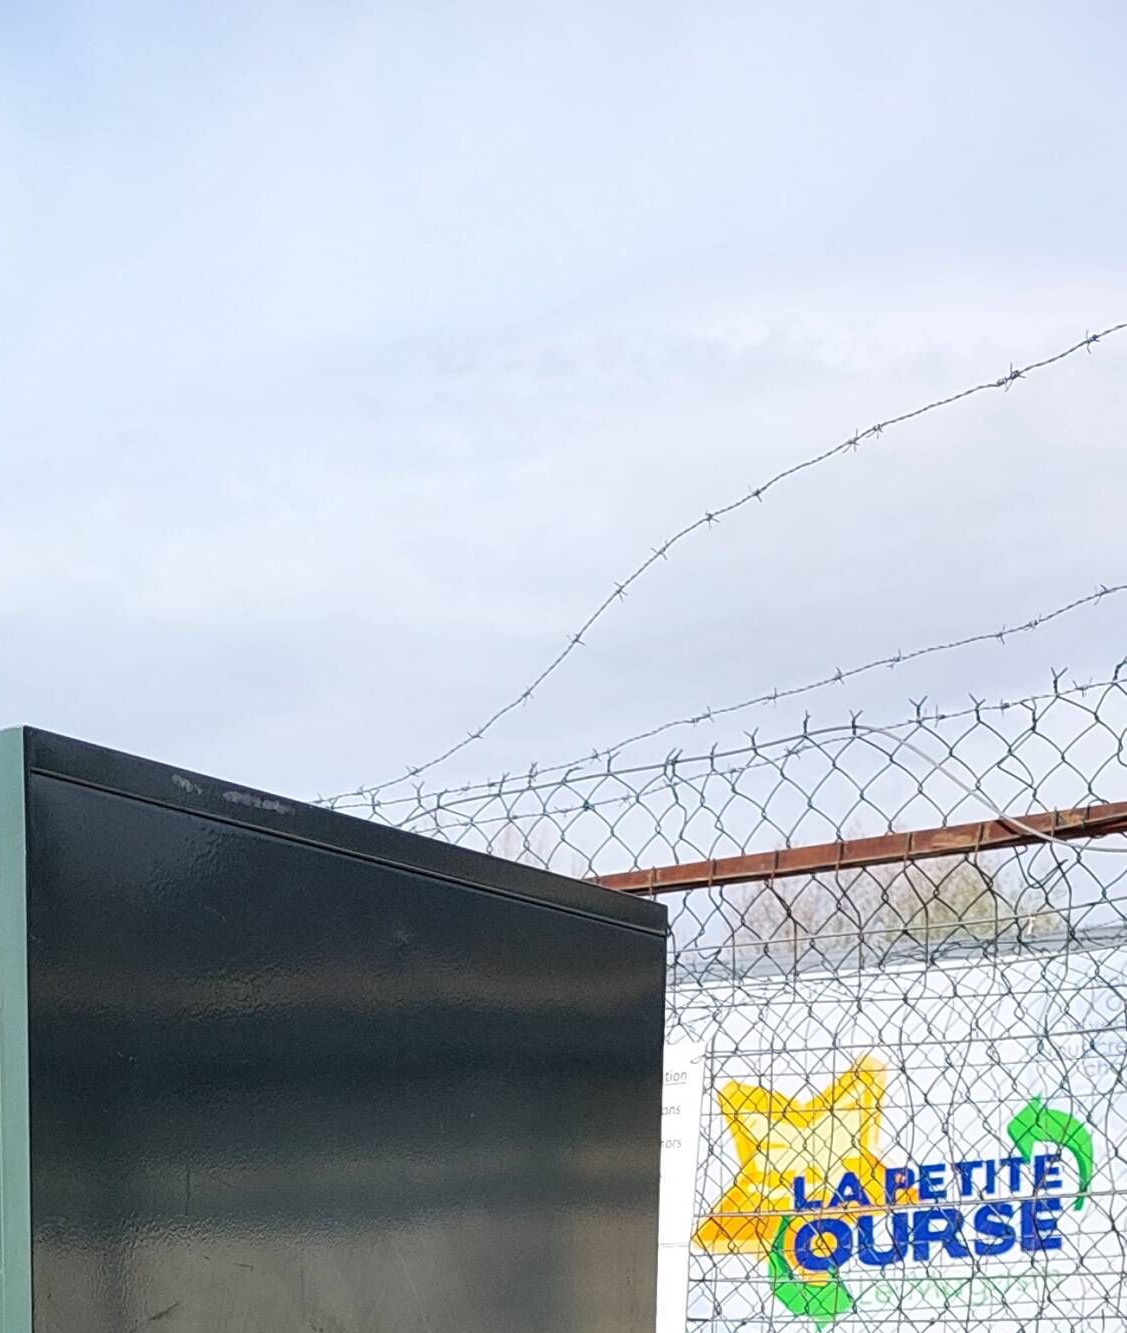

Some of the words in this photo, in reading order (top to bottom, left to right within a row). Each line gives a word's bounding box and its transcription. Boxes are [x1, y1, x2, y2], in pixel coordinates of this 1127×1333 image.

[793, 1172, 873, 1211] LA
[885, 1154, 1062, 1204] PETITE
[794, 1198, 1062, 1270] OURSE
